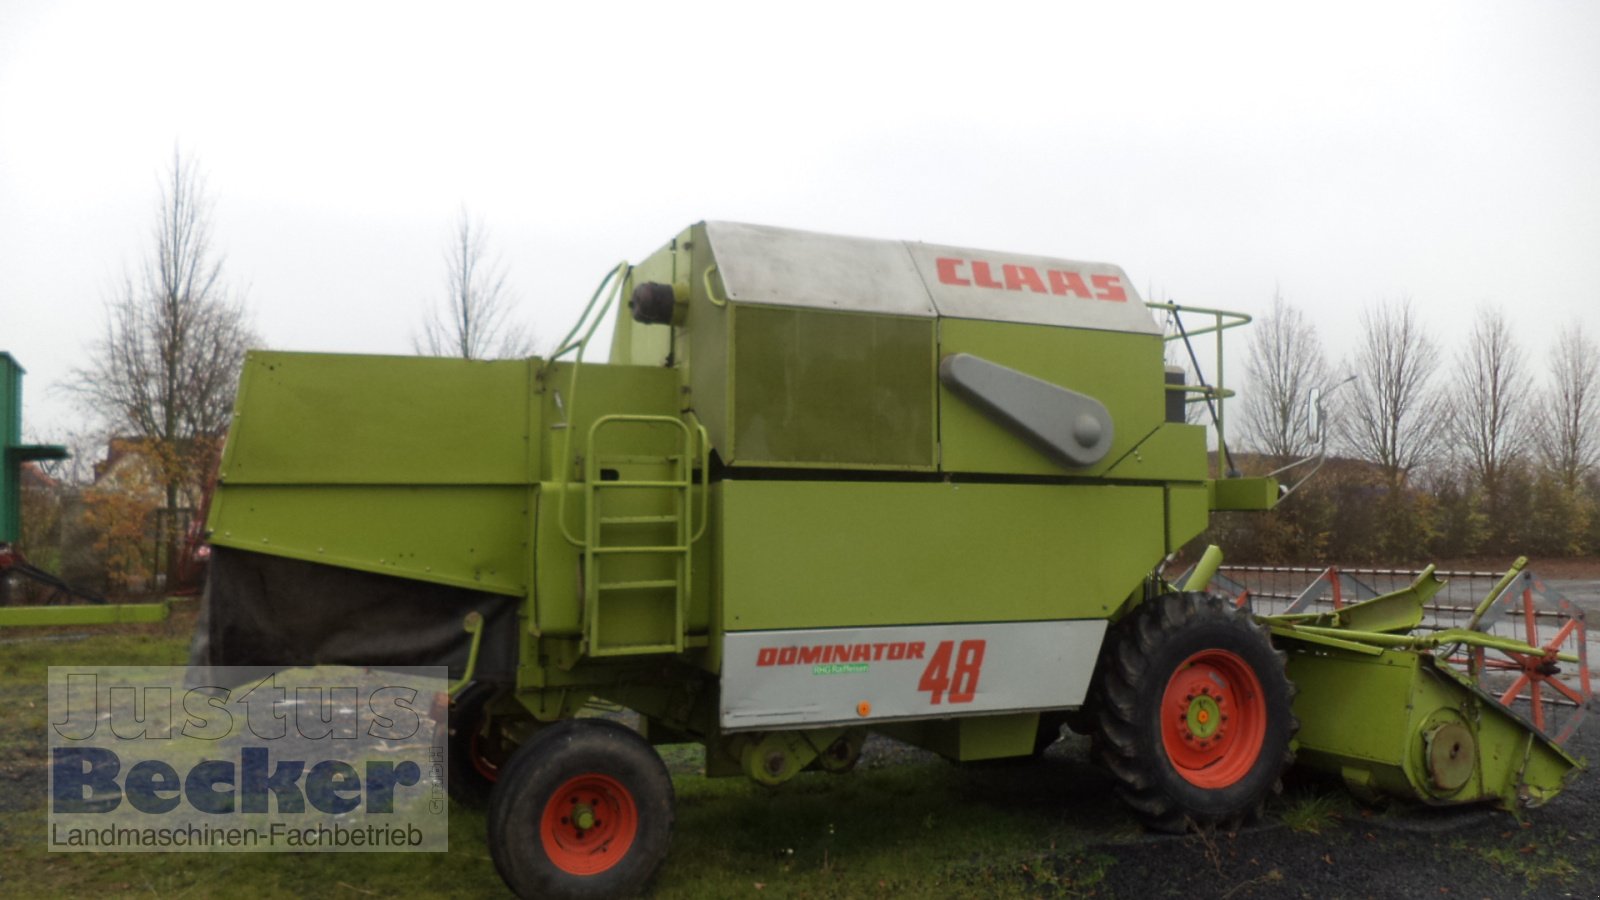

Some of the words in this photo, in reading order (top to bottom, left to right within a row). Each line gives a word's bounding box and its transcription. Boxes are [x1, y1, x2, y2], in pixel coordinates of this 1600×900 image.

[936, 257, 1128, 302] CLAAS
[756, 641, 926, 667] DOMINATOR
[917, 639, 986, 705] 48
